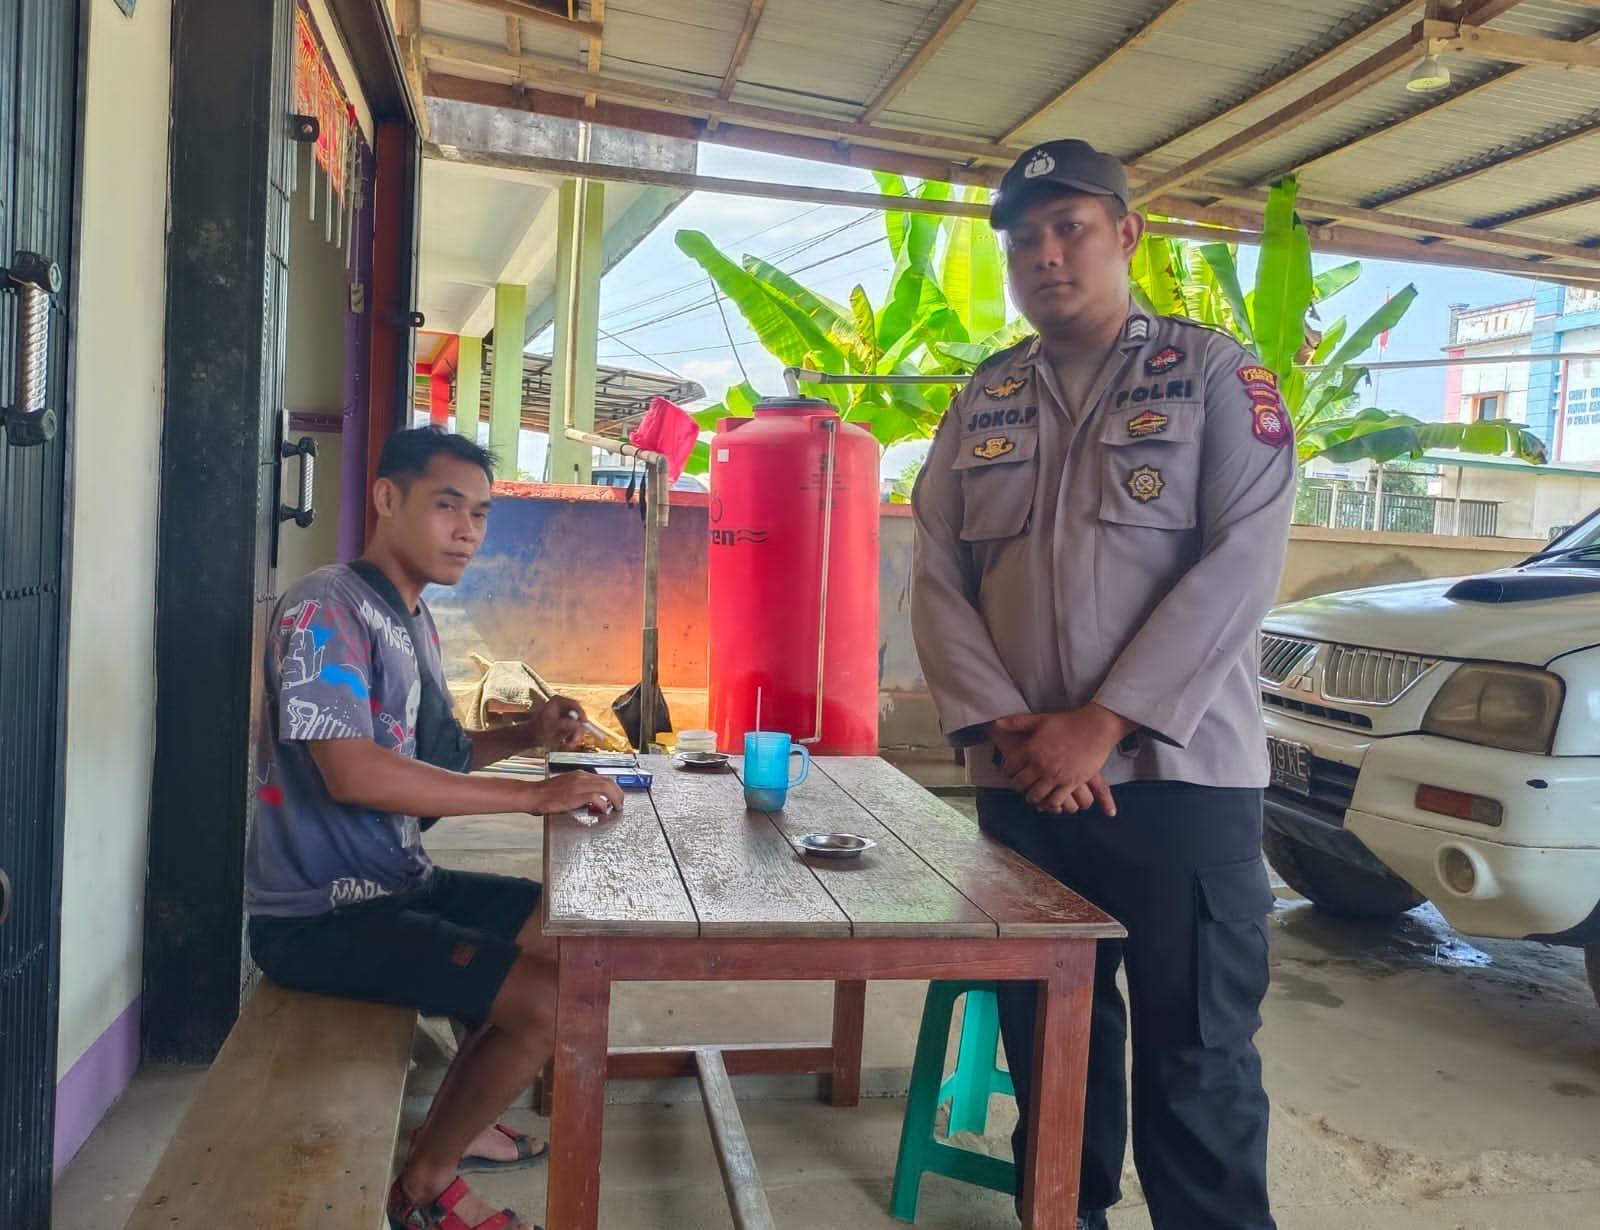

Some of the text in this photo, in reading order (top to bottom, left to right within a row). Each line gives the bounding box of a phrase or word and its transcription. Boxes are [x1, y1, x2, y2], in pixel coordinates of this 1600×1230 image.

[1116, 379, 1193, 409] POLRI
[968, 406, 1038, 432] JOKO.P
[709, 529, 735, 546] en
